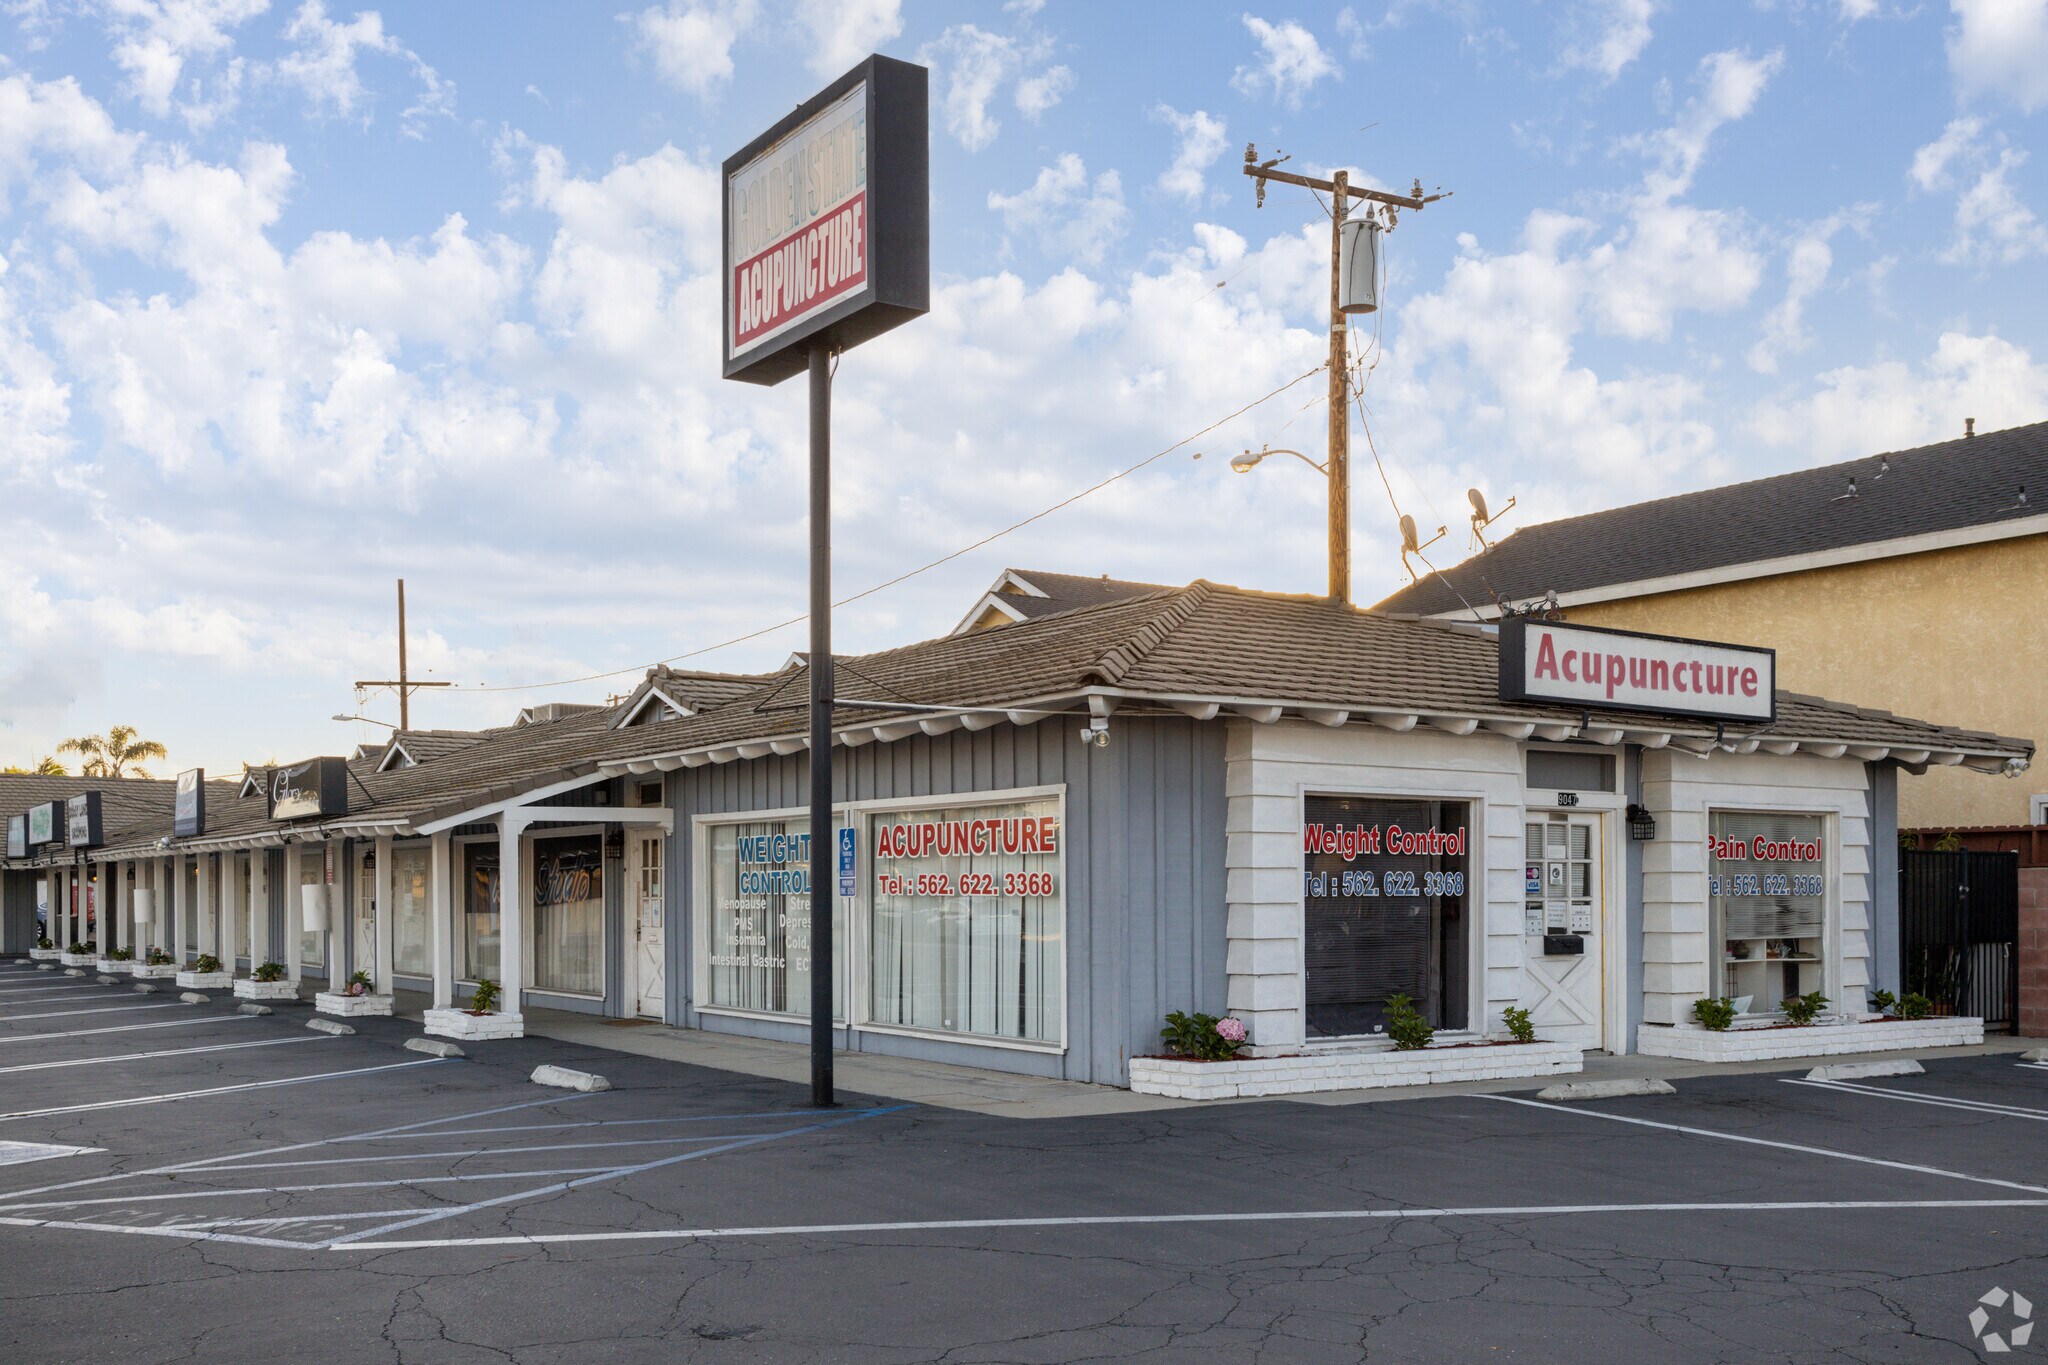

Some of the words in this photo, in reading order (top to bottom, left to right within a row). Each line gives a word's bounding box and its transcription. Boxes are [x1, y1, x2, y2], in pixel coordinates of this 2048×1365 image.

[739, 200, 862, 336] ACUPUNCTURE
[1534, 633, 1758, 699] Acupuncture
[738, 832, 811, 865] WEIGHT
[877, 816, 1056, 859] ACUPUNCTURE
[1305, 823, 1380, 861] Weight
[1386, 825, 1465, 855] Control
[1709, 834, 1746, 860] Pain
[1753, 835, 1821, 861] Control
[739, 870, 811, 895] CONTROL
[918, 873, 954, 896] 562.
[959, 873, 999, 896] 622.
[1004, 872, 1053, 897] 3368
[1342, 871, 1379, 897] 562.
[1383, 871, 1420, 897] 622.
[1424, 871, 1464, 897] 3368
[1734, 874, 1761, 896] 562.
[1764, 874, 1790, 896] 622.
[1794, 874, 1822, 896] 3368
[717, 897, 766, 912] Menopause
[734, 917, 753, 931] PMS
[726, 932, 766, 946] Insomnia
[709, 952, 749, 967] Intestinal
[751, 954, 786, 969] Gastric
